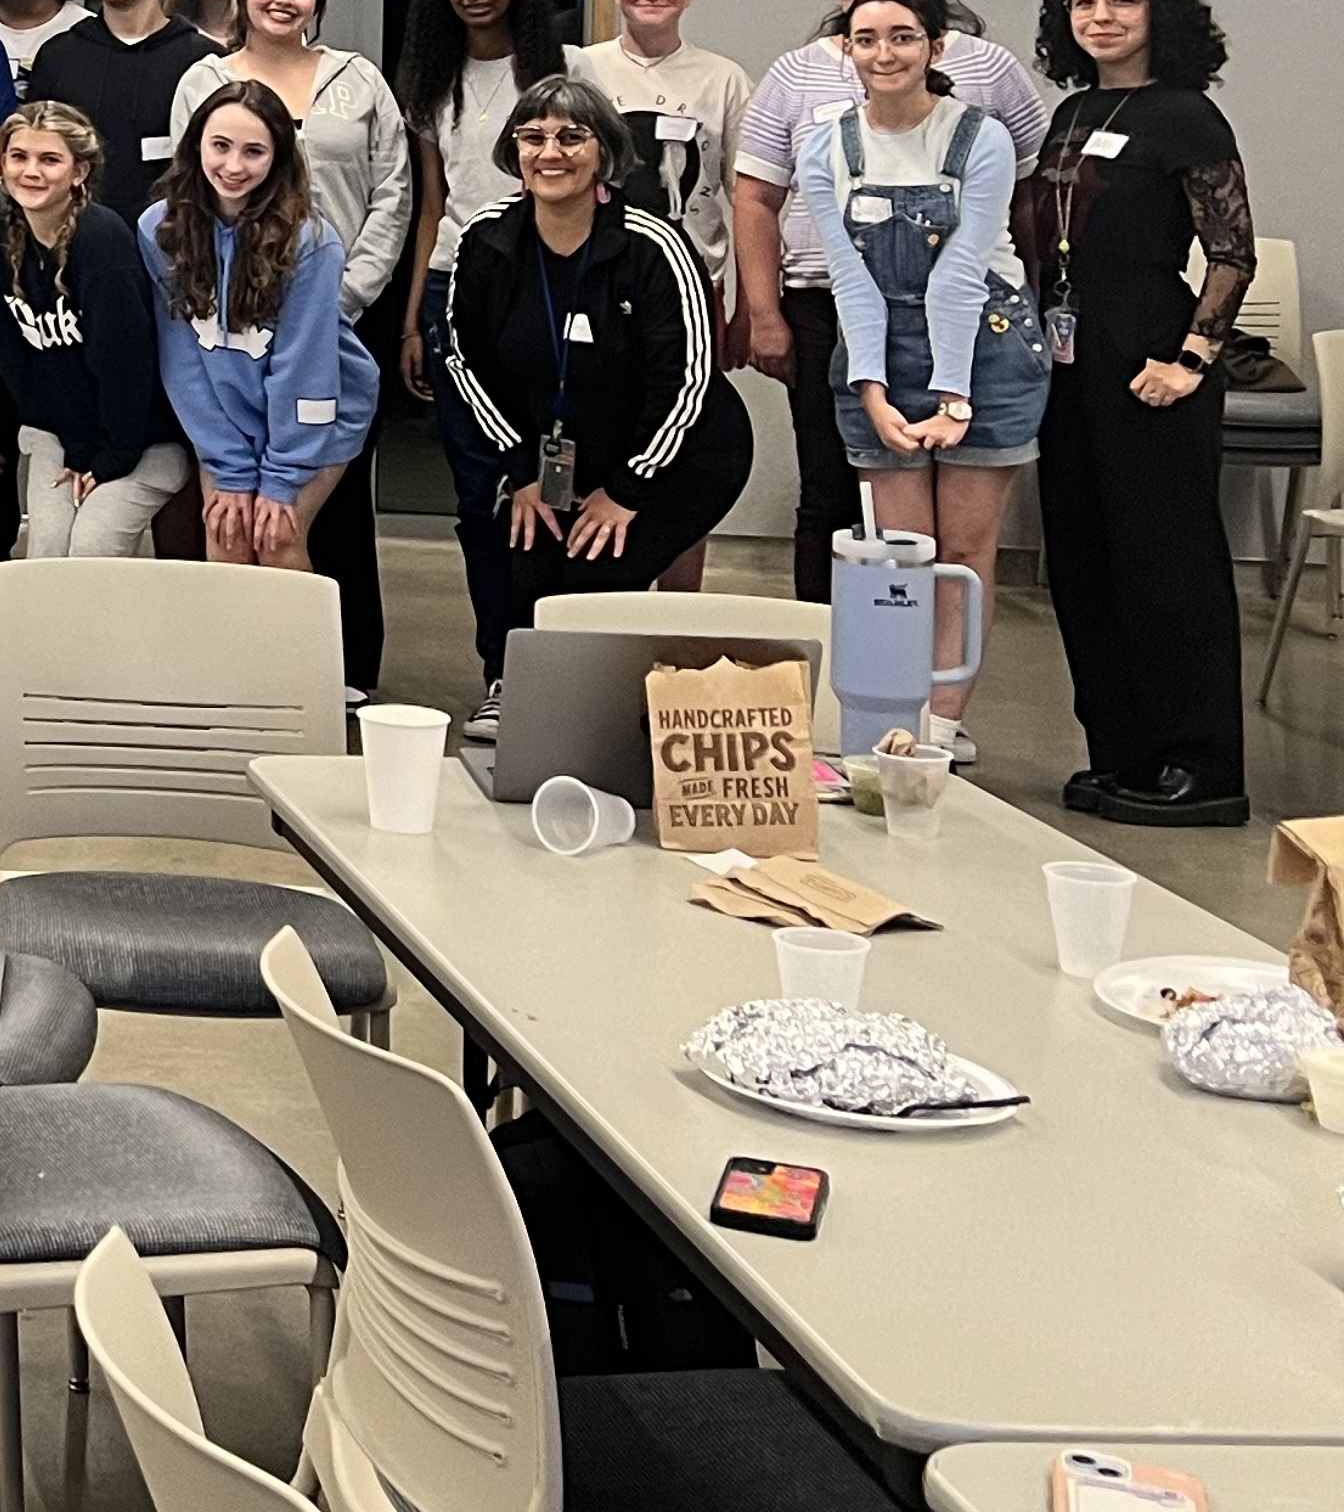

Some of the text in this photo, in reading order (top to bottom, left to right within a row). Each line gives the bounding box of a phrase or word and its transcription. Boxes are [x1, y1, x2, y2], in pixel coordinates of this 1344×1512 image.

[3, 294, 84, 351] Duk
[658, 707, 793, 729] HANDCRAFTED
[661, 730, 797, 773] CHIPS
[682, 776, 789, 799] MADE FRESH
[669, 802, 800, 828] EVERY DAY
